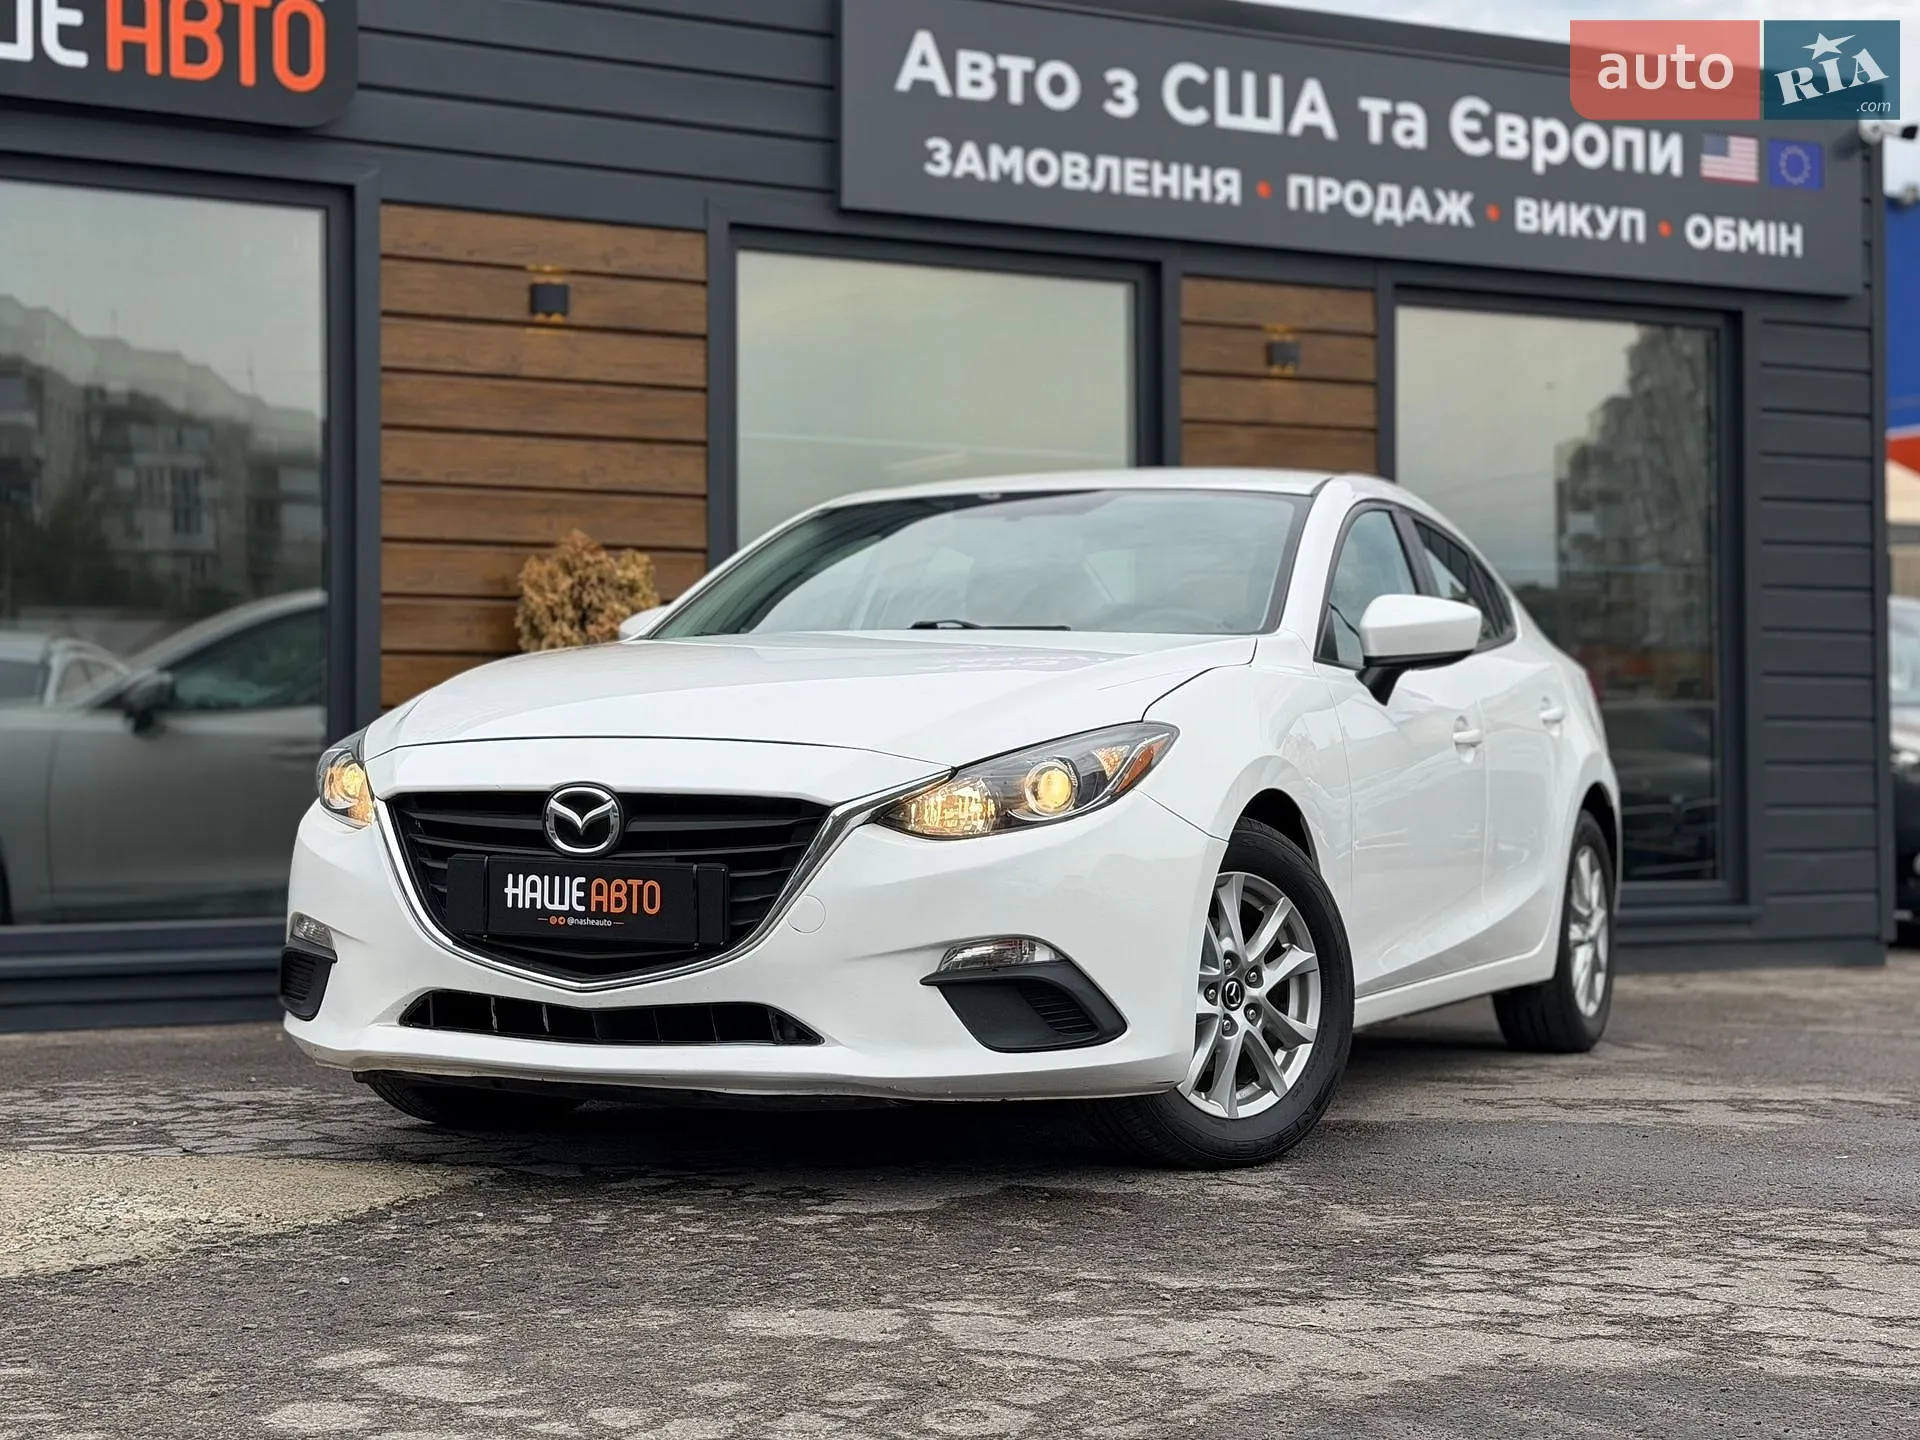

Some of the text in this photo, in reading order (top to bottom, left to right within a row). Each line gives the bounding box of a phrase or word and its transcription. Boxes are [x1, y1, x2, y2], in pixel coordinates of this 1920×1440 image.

[106, 0, 327, 93] АВТО
[895, 29, 1684, 177] Авто з США та Європи
[924, 137, 1804, 258] ЗАМОВЛЕННЯ ПРОДАЖ ВИКУП ОБМІН
[504, 873, 661, 915] НАШЕ АВТО
[567, 916, 612, 927] @nasheauto
